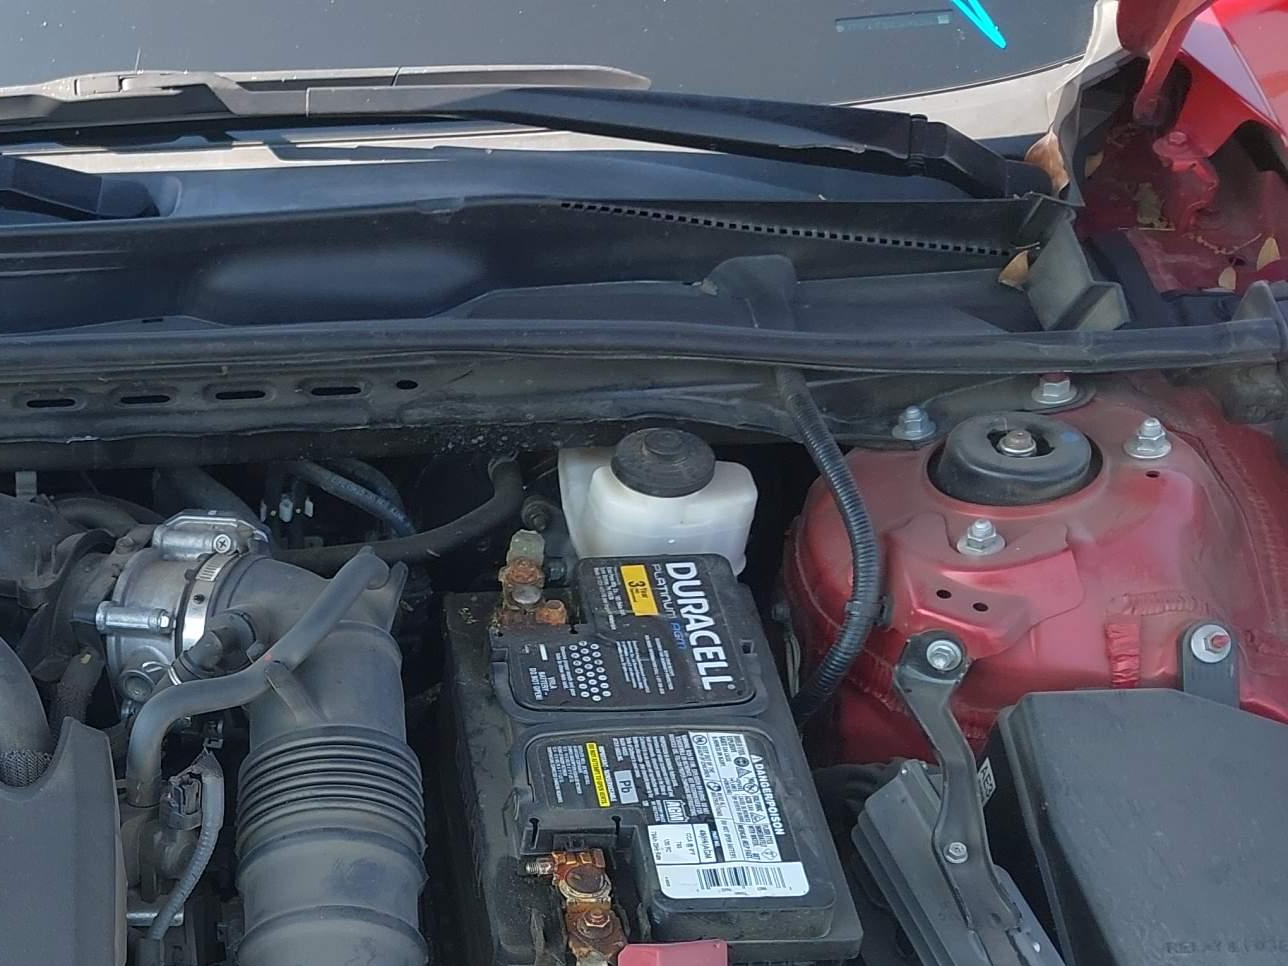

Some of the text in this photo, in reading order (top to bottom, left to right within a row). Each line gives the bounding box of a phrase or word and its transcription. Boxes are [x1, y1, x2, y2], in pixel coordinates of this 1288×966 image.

[652, 564, 676, 618] PLATINUM
[671, 623, 687, 649] AGM
[666, 563, 733, 690] DURACELL
[619, 780, 632, 793] Pb
[666, 802, 683, 820] AGM
[755, 764, 785, 835] DANGER/POISON
